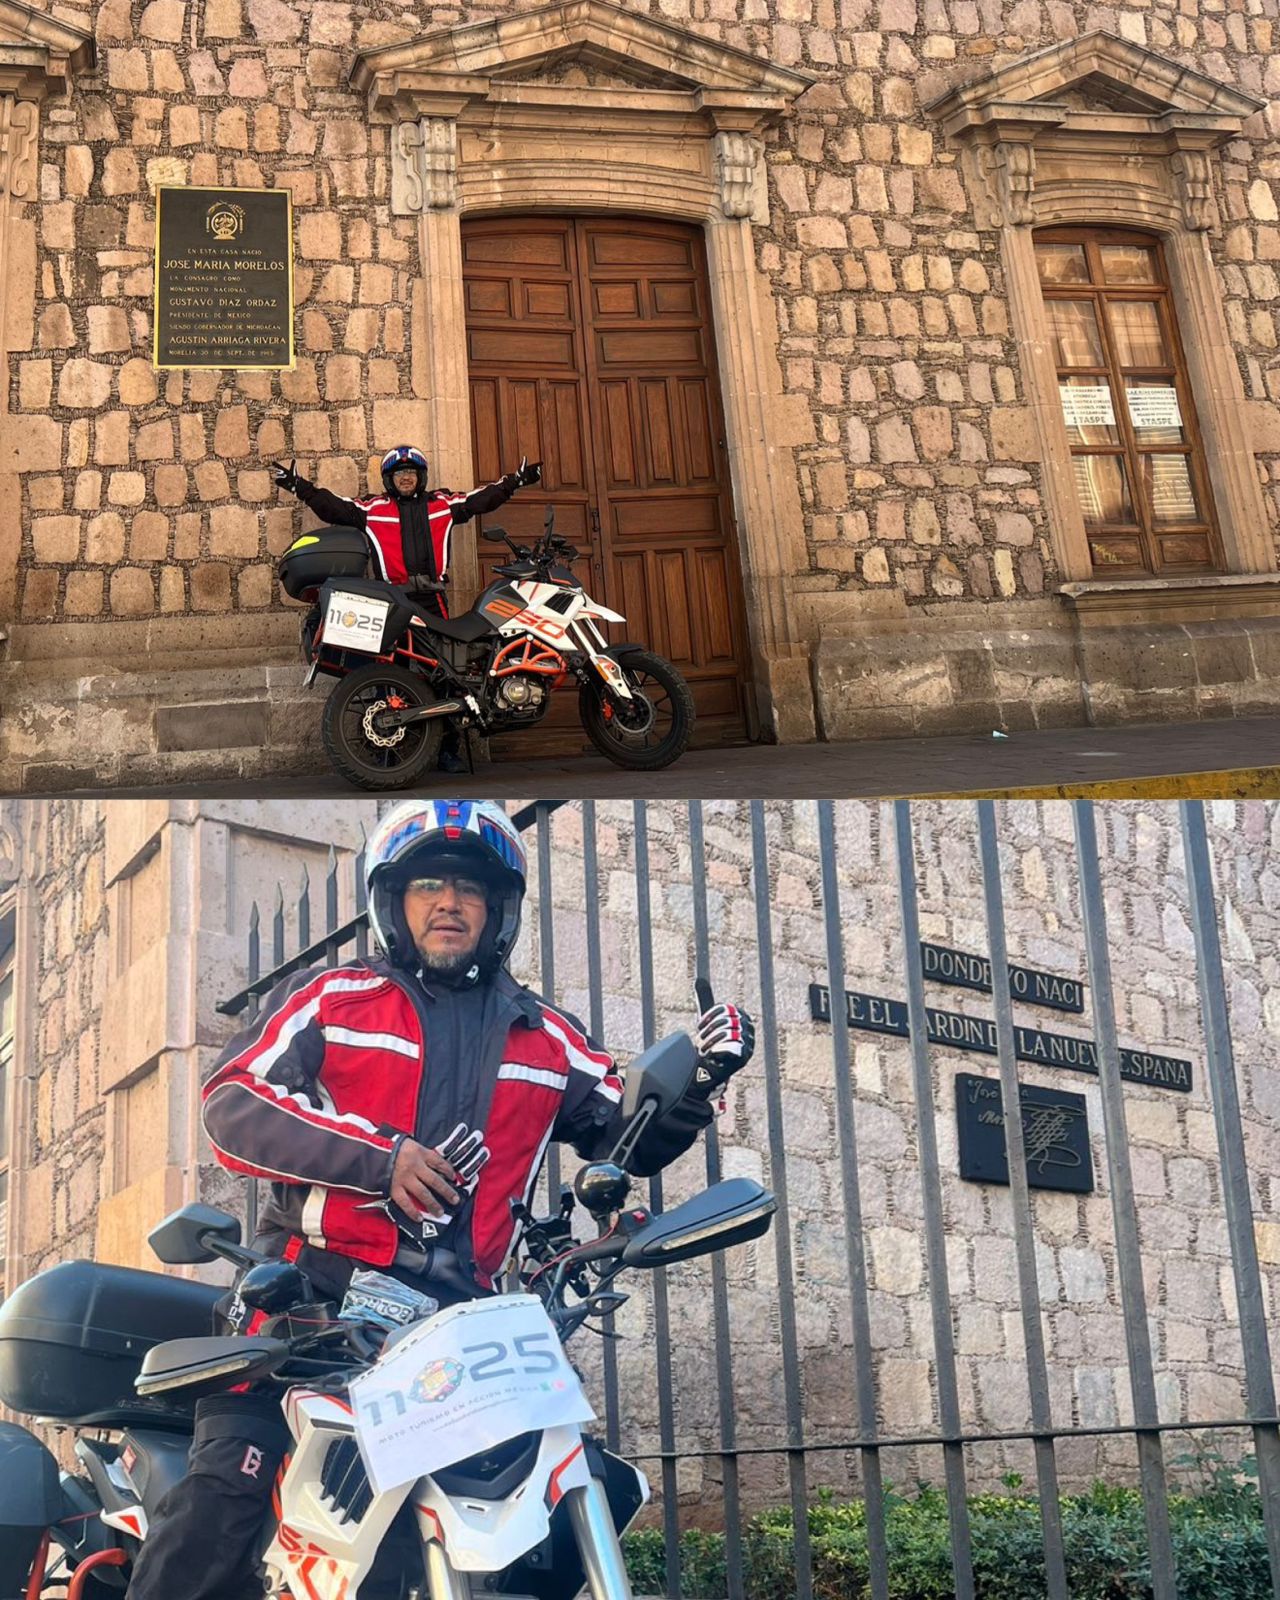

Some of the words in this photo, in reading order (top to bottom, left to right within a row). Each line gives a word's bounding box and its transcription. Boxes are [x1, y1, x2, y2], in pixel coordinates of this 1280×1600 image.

[163, 260, 191, 269] JOSE
[194, 260, 231, 270] MARIA
[234, 260, 285, 271] MORELOS
[169, 298, 214, 306] GUSTAVO
[219, 299, 241, 307] DIAZ
[246, 299, 277, 307] ORDAZ
[169, 335, 208, 344] AGUSTIN
[210, 336, 251, 344] ARRIAGA
[253, 336, 287, 345] RIVERA
[1140, 417, 1173, 426] STASPE
[924, 946, 993, 986] DONDE
[1035, 974, 1081, 1007] NACI
[819, 988, 865, 1021] FE
[869, 999, 899, 1028] EL
[906, 1010, 985, 1046] ARDIN
[1019, 1030, 1048, 1058] LA
[1049, 1036, 1100, 1068] NUEV
